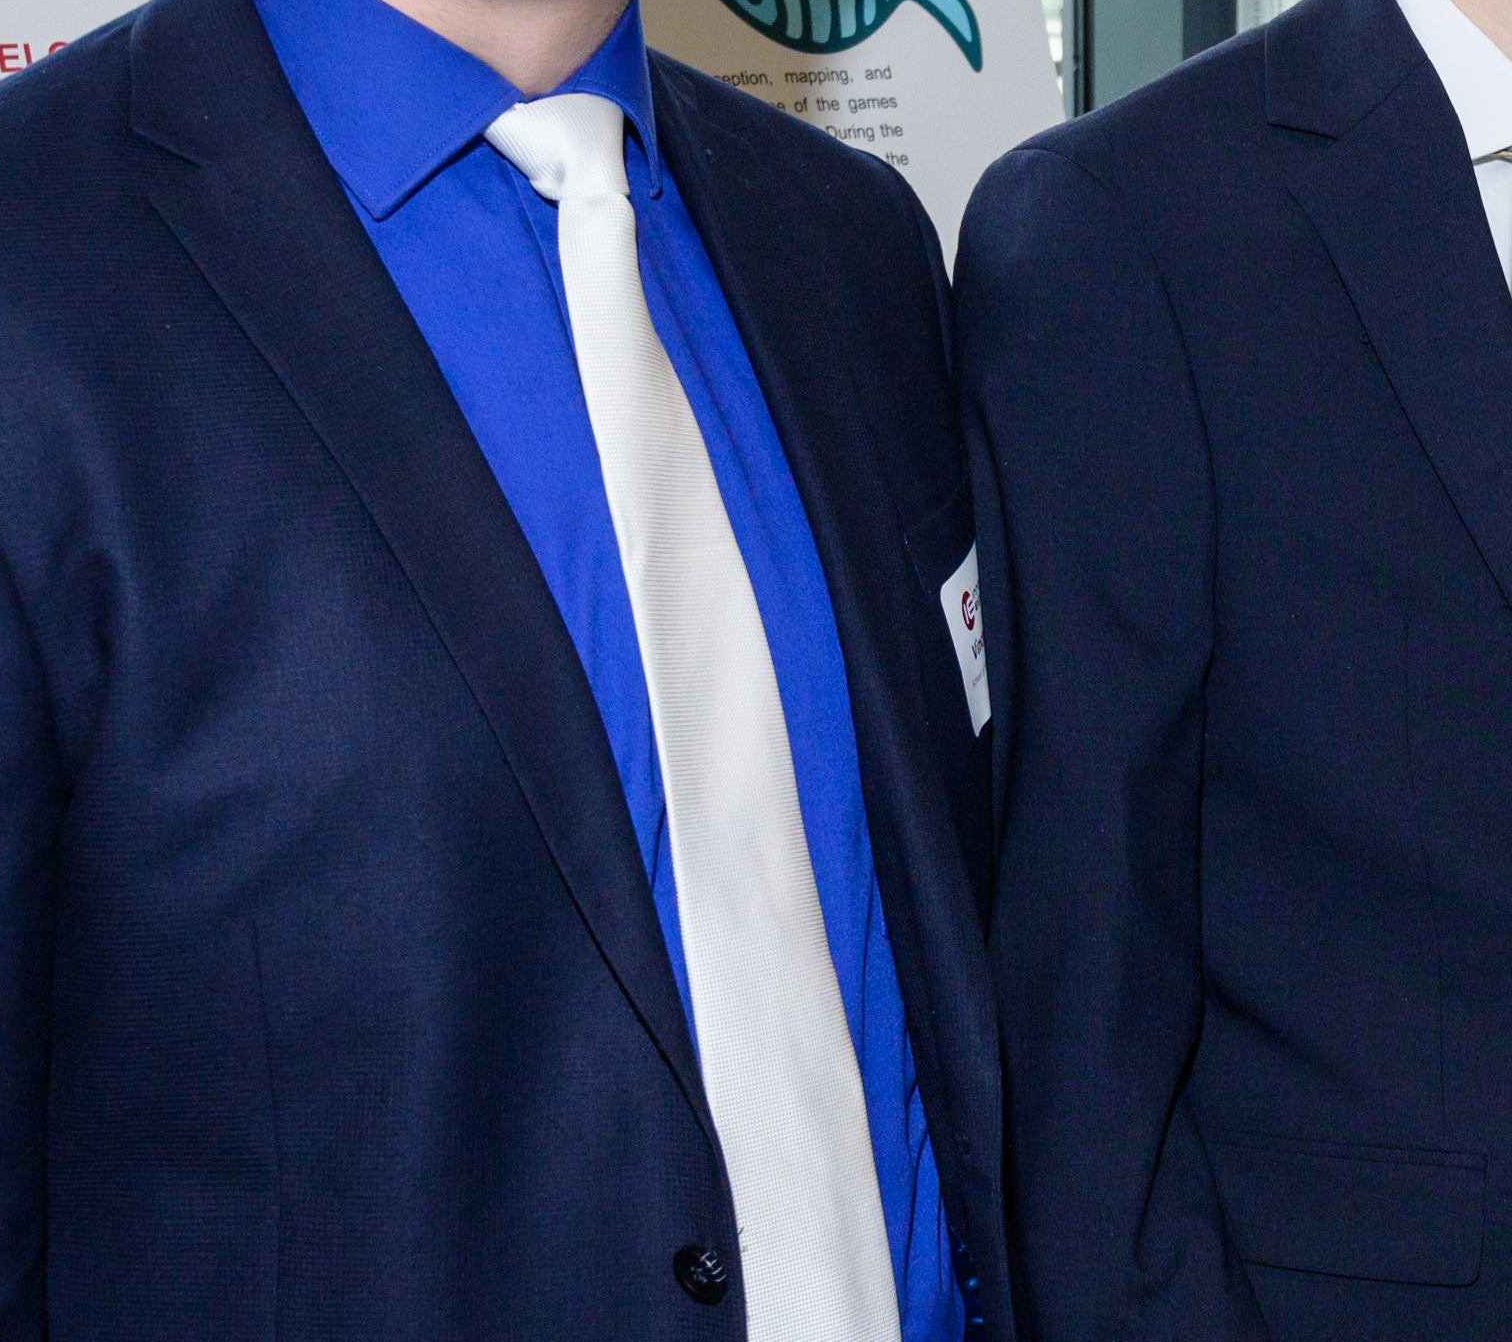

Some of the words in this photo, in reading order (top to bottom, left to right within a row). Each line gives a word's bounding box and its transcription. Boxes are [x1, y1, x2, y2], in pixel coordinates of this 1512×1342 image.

[784, 66, 855, 86] mapping,
[864, 65, 893, 81] and
[794, 97, 808, 113] of
[816, 97, 840, 112] the
[848, 96, 898, 114] games
[826, 124, 876, 143] During
[880, 123, 904, 138] the
[885, 151, 909, 166] the
